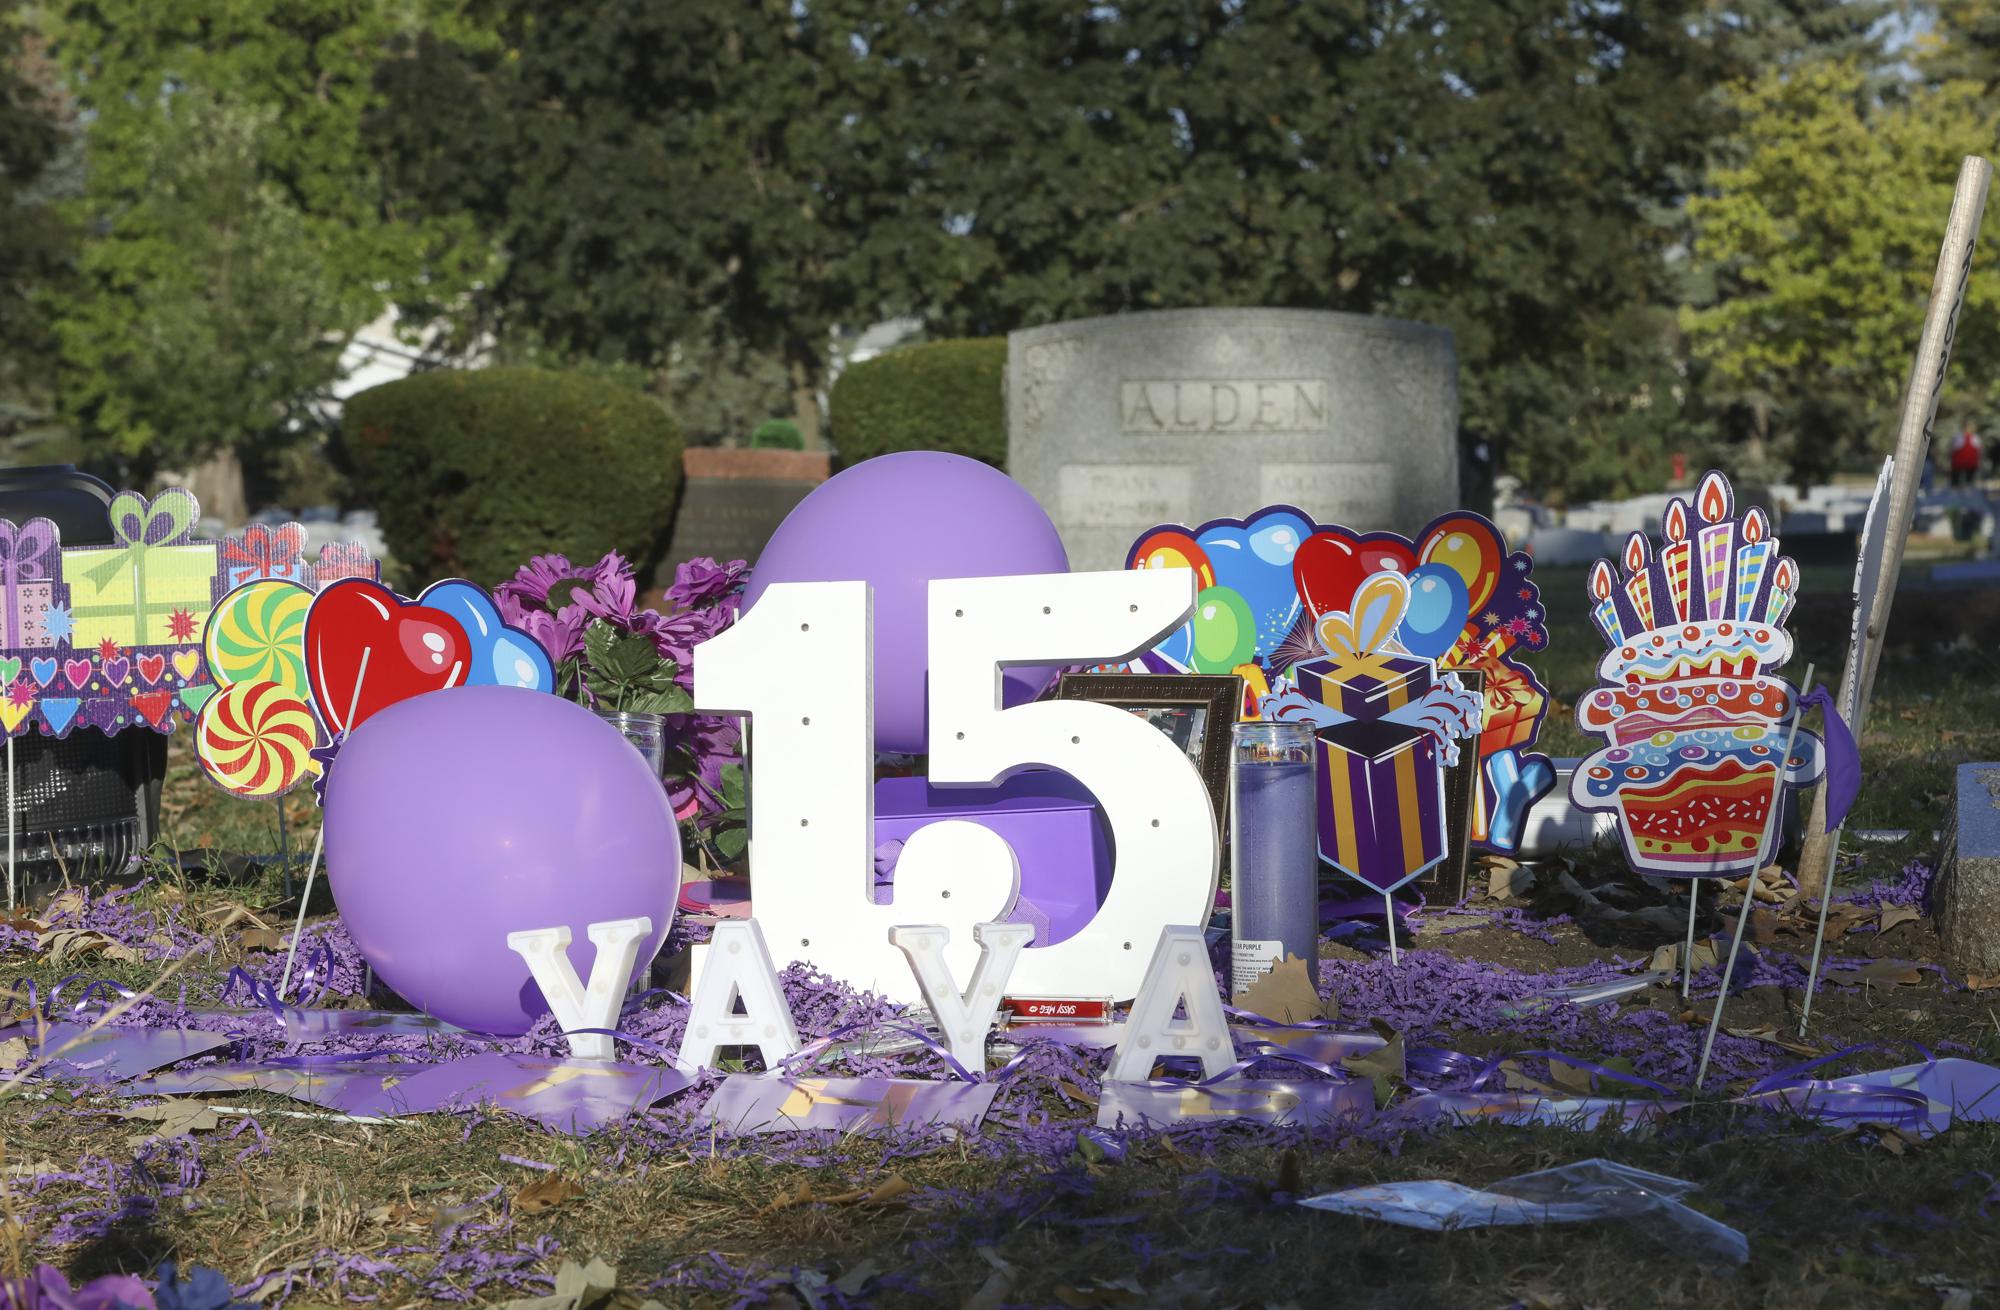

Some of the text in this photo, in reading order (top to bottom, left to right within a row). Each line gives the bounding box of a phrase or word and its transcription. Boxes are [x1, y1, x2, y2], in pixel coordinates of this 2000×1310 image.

[1128, 382, 1326, 429] ALDEN
[692, 567, 1217, 1006] 15
[1242, 943, 1262, 951] PURPLE
[1039, 1003, 1077, 1016] SASSY MEG
